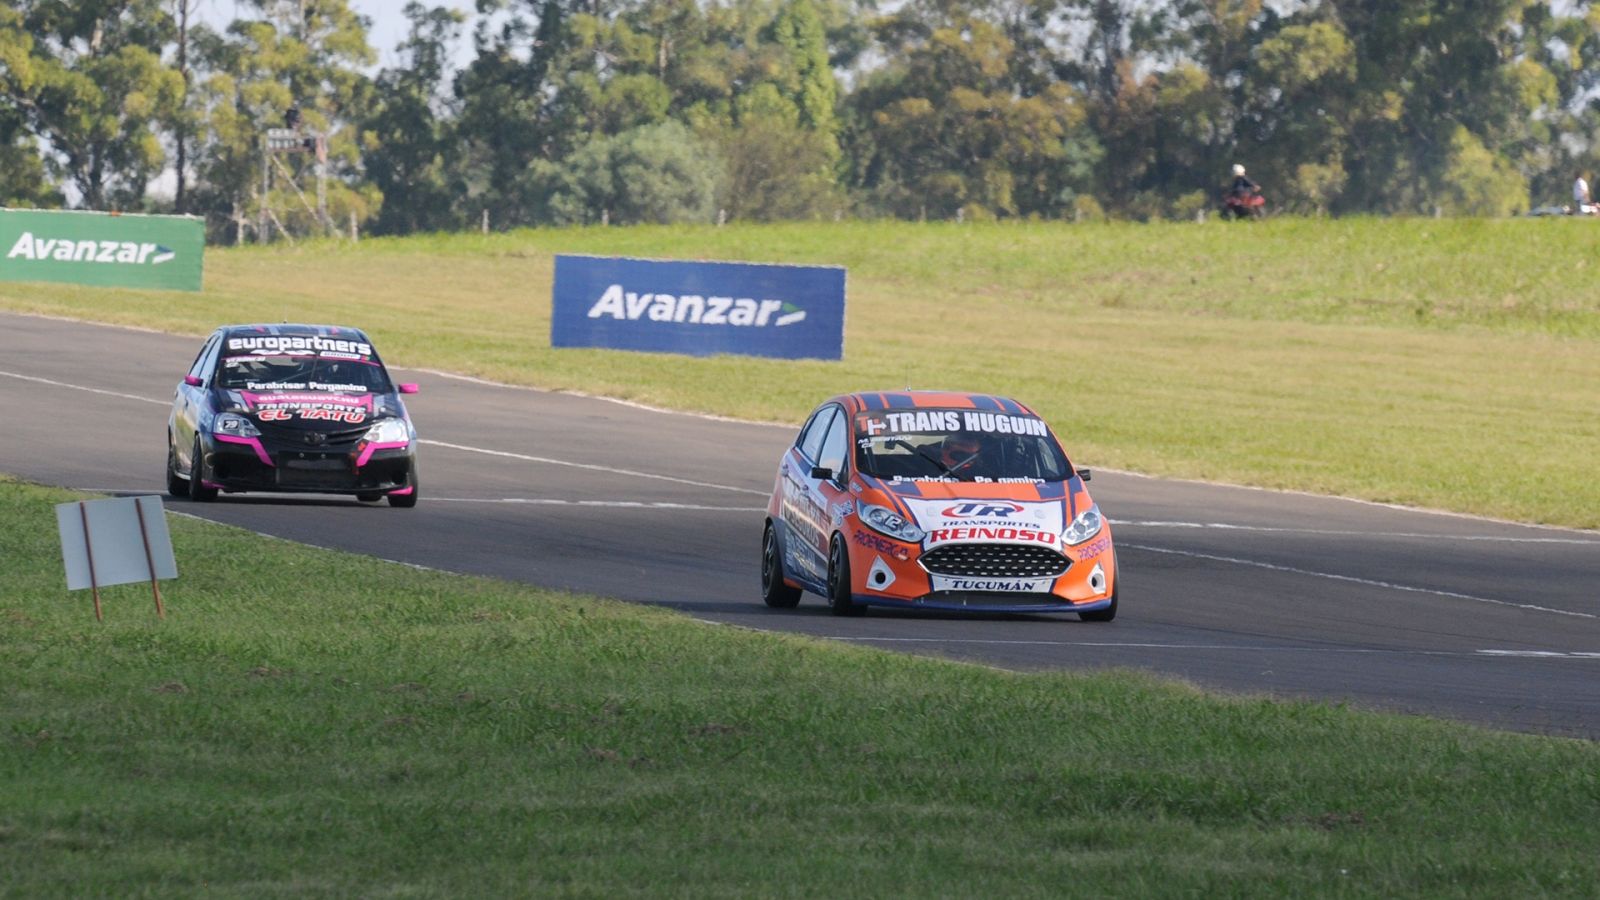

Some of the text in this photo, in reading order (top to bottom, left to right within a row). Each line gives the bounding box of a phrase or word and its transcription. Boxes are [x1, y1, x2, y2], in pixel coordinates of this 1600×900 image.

[8, 232, 157, 264] Avanzar
[587, 284, 782, 326] Avanzar
[228, 336, 372, 355] europartners
[247, 382, 367, 393] Parabrisar Pergamino
[257, 403, 366, 413] TRANSPORTE
[259, 408, 366, 424] EL TATU
[886, 412, 1049, 437] TRANS HUGUIN
[957, 503, 1013, 518] TR
[884, 514, 904, 531] 12
[942, 520, 1041, 528] TRANSPORTES
[929, 528, 1056, 544] REINOSO
[952, 579, 1036, 591] TUCUMÁN
